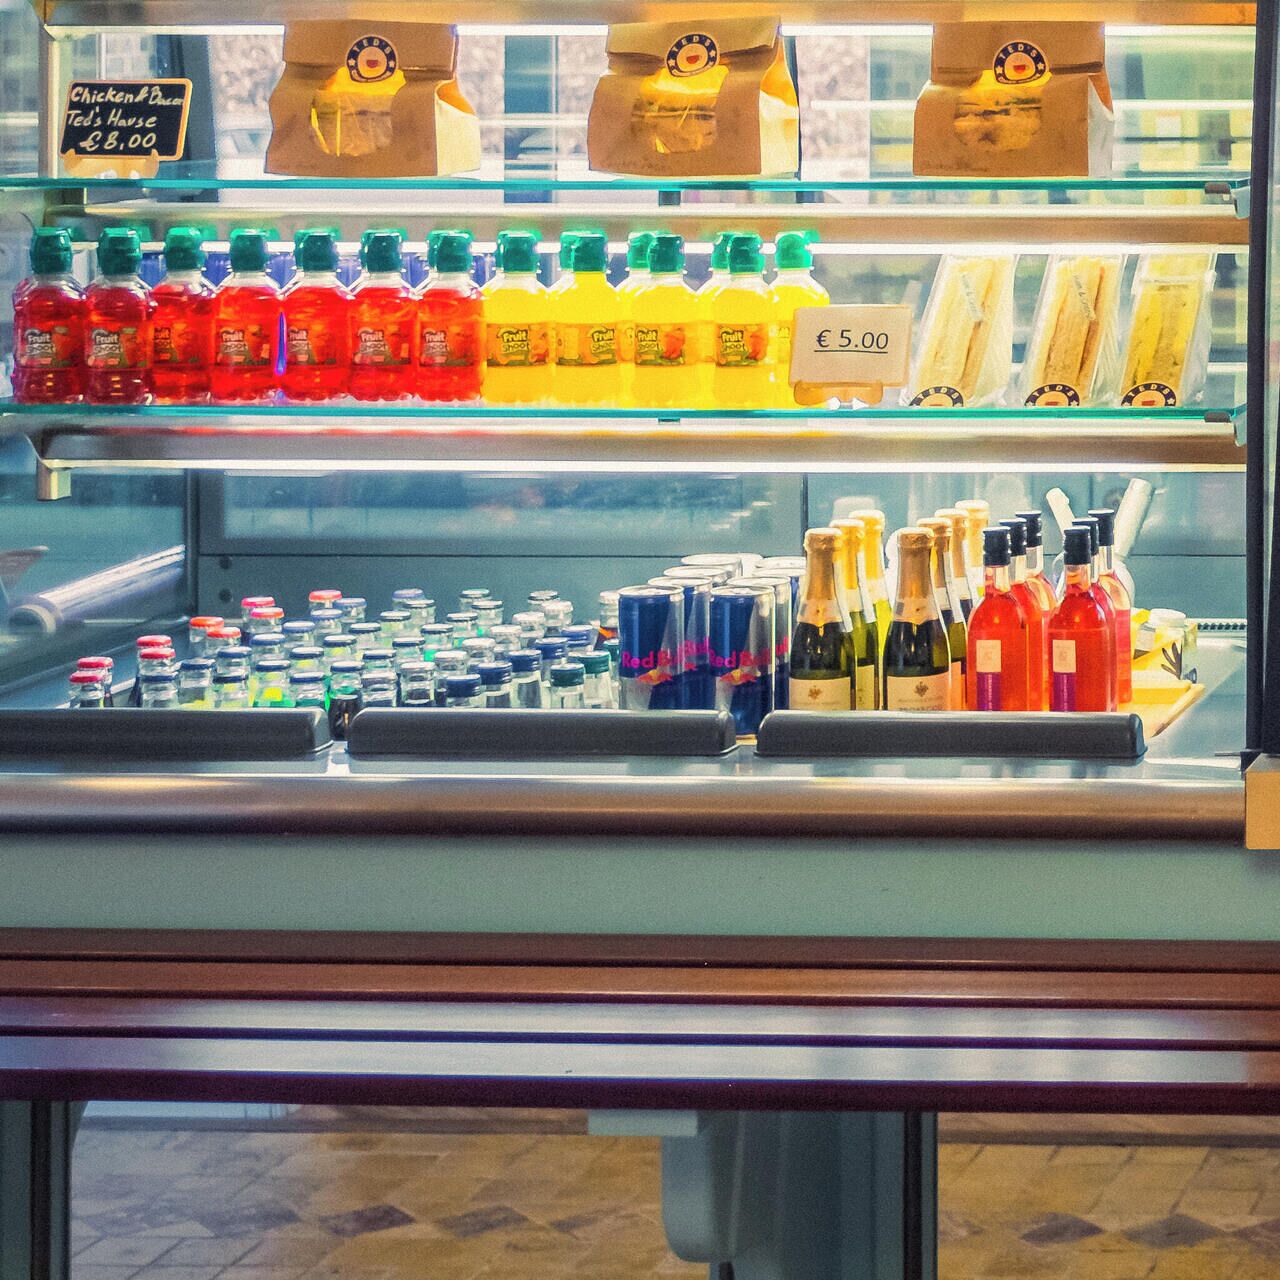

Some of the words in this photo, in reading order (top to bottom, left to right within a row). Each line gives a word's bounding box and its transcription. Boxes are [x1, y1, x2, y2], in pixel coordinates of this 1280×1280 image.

[67, 106, 102, 127] Ted's
[622, 651, 654, 669] Red
[709, 649, 737, 668] Red
